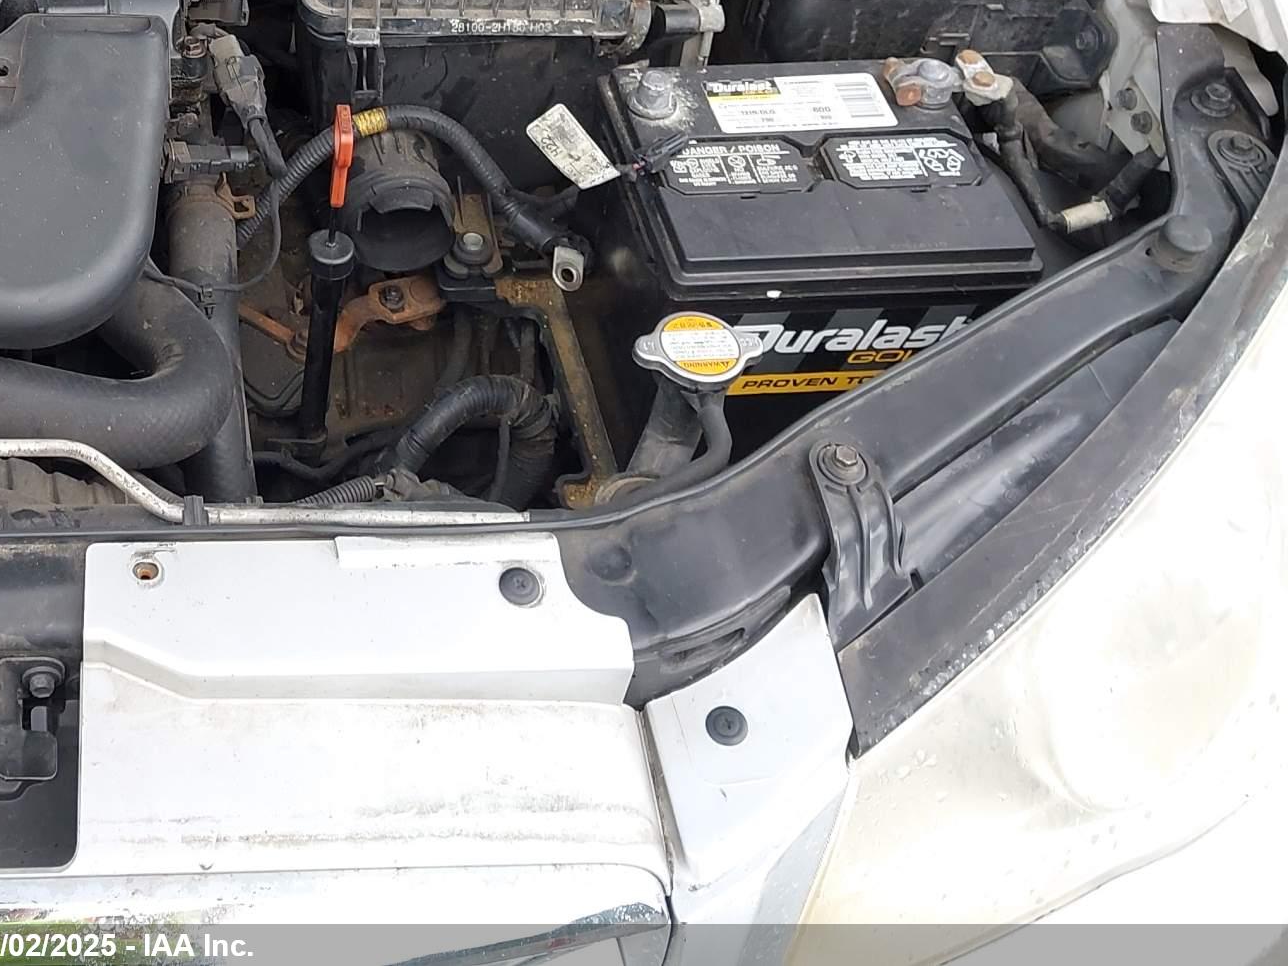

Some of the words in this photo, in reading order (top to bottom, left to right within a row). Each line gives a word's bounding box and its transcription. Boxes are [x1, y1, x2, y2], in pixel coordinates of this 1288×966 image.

[738, 144, 781, 153] POISON
[733, 316, 969, 354] Duralast
[742, 377, 838, 390] PROVEN
